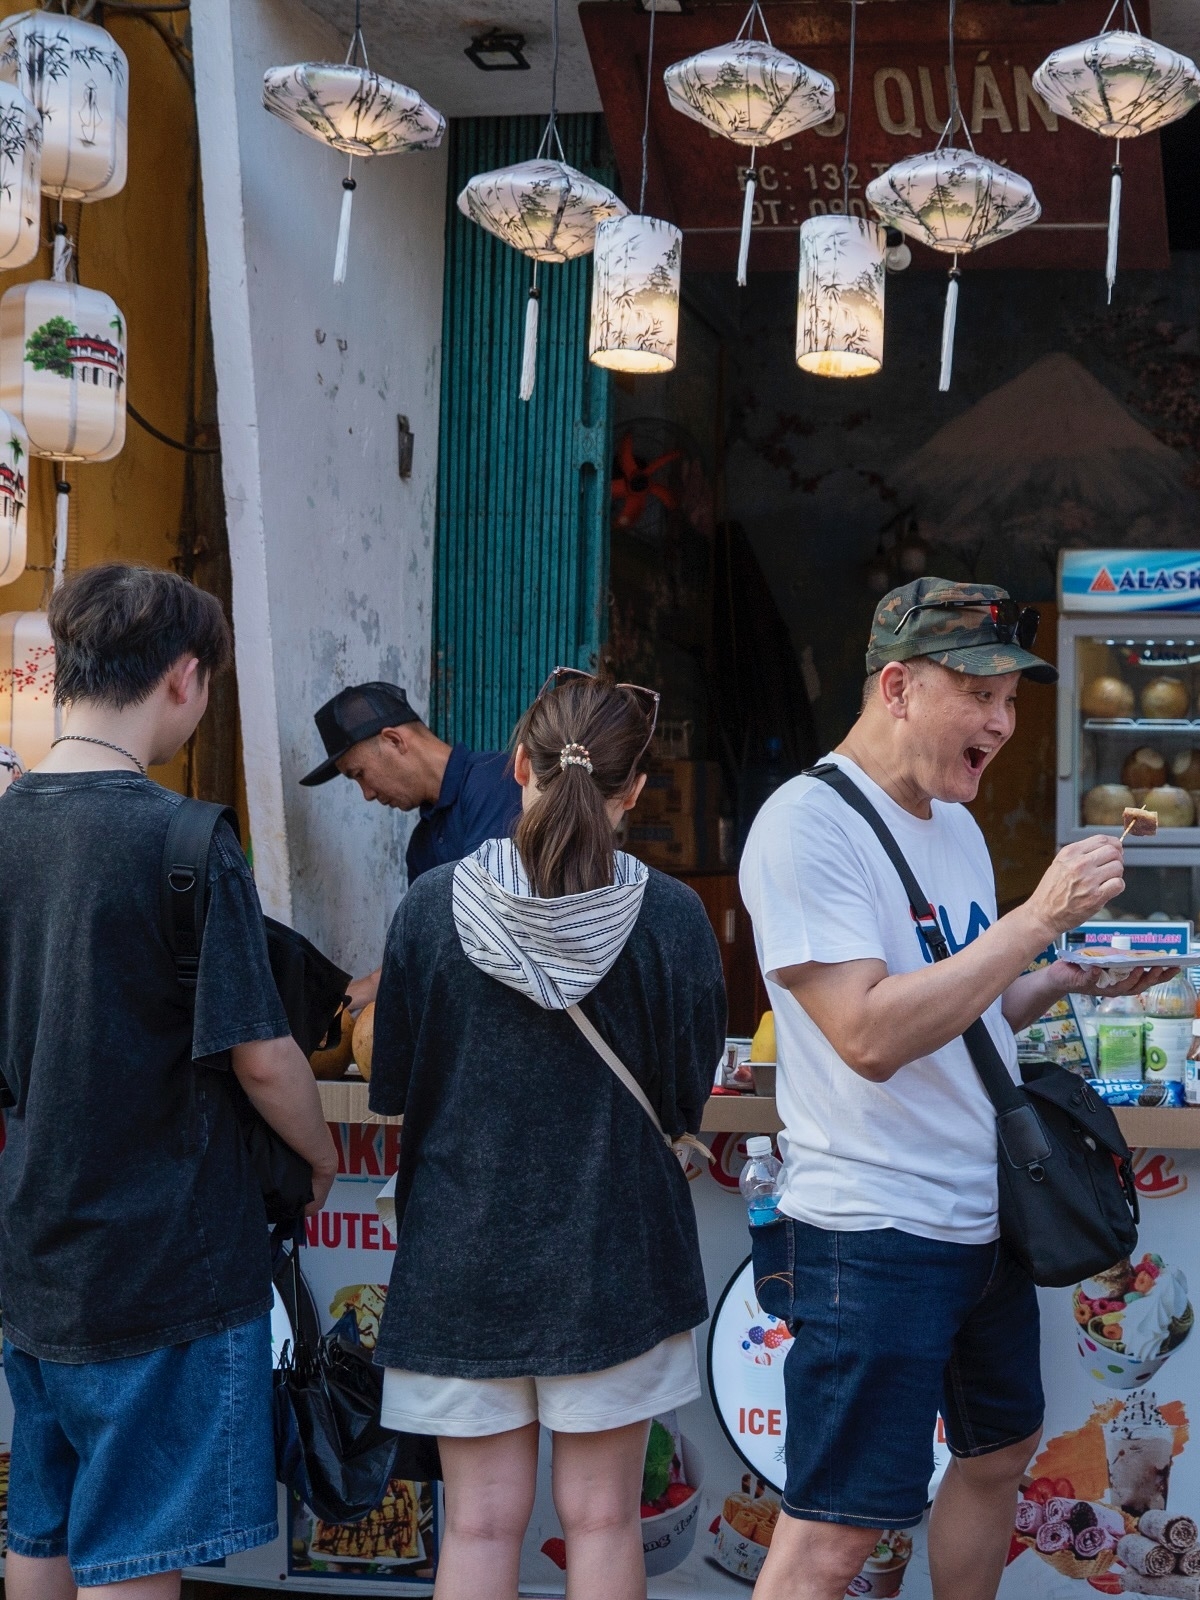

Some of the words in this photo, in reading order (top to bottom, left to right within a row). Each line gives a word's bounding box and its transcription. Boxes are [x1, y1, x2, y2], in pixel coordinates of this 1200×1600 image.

[873, 50, 1060, 138] QUÁN
[803, 163, 862, 190] 132
[738, 1407, 782, 1436] ICE
